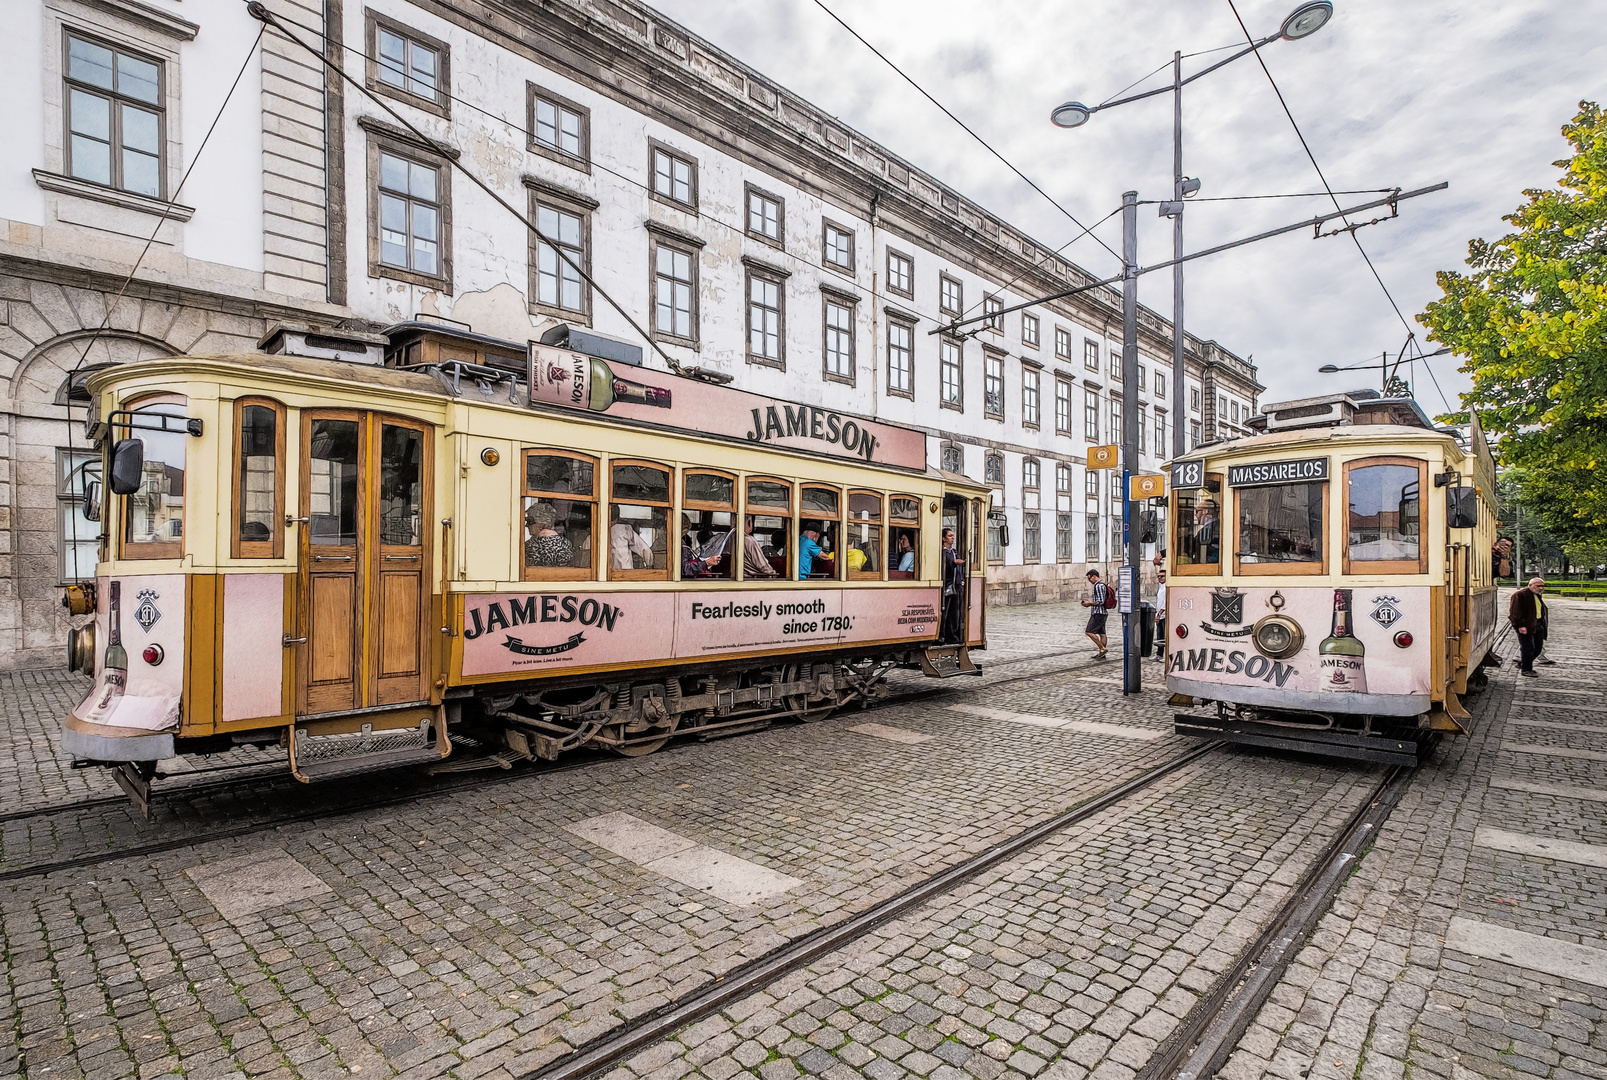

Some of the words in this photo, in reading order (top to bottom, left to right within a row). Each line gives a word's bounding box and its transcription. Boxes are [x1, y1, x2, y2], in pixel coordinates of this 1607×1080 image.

[571, 354, 584, 404] JAMESON
[747, 405, 877, 462] JAMESON
[1175, 463, 1199, 485] 18
[1232, 461, 1323, 483] MASSARELOS
[691, 601, 772, 620] Fearlessly
[776, 598, 825, 616] smooth
[1178, 599, 1194, 610] 131
[464, 595, 620, 640] JAMESON
[782, 619, 818, 634] since
[545, 645, 569, 653] METU
[1320, 659, 1361, 671] JAMESON
